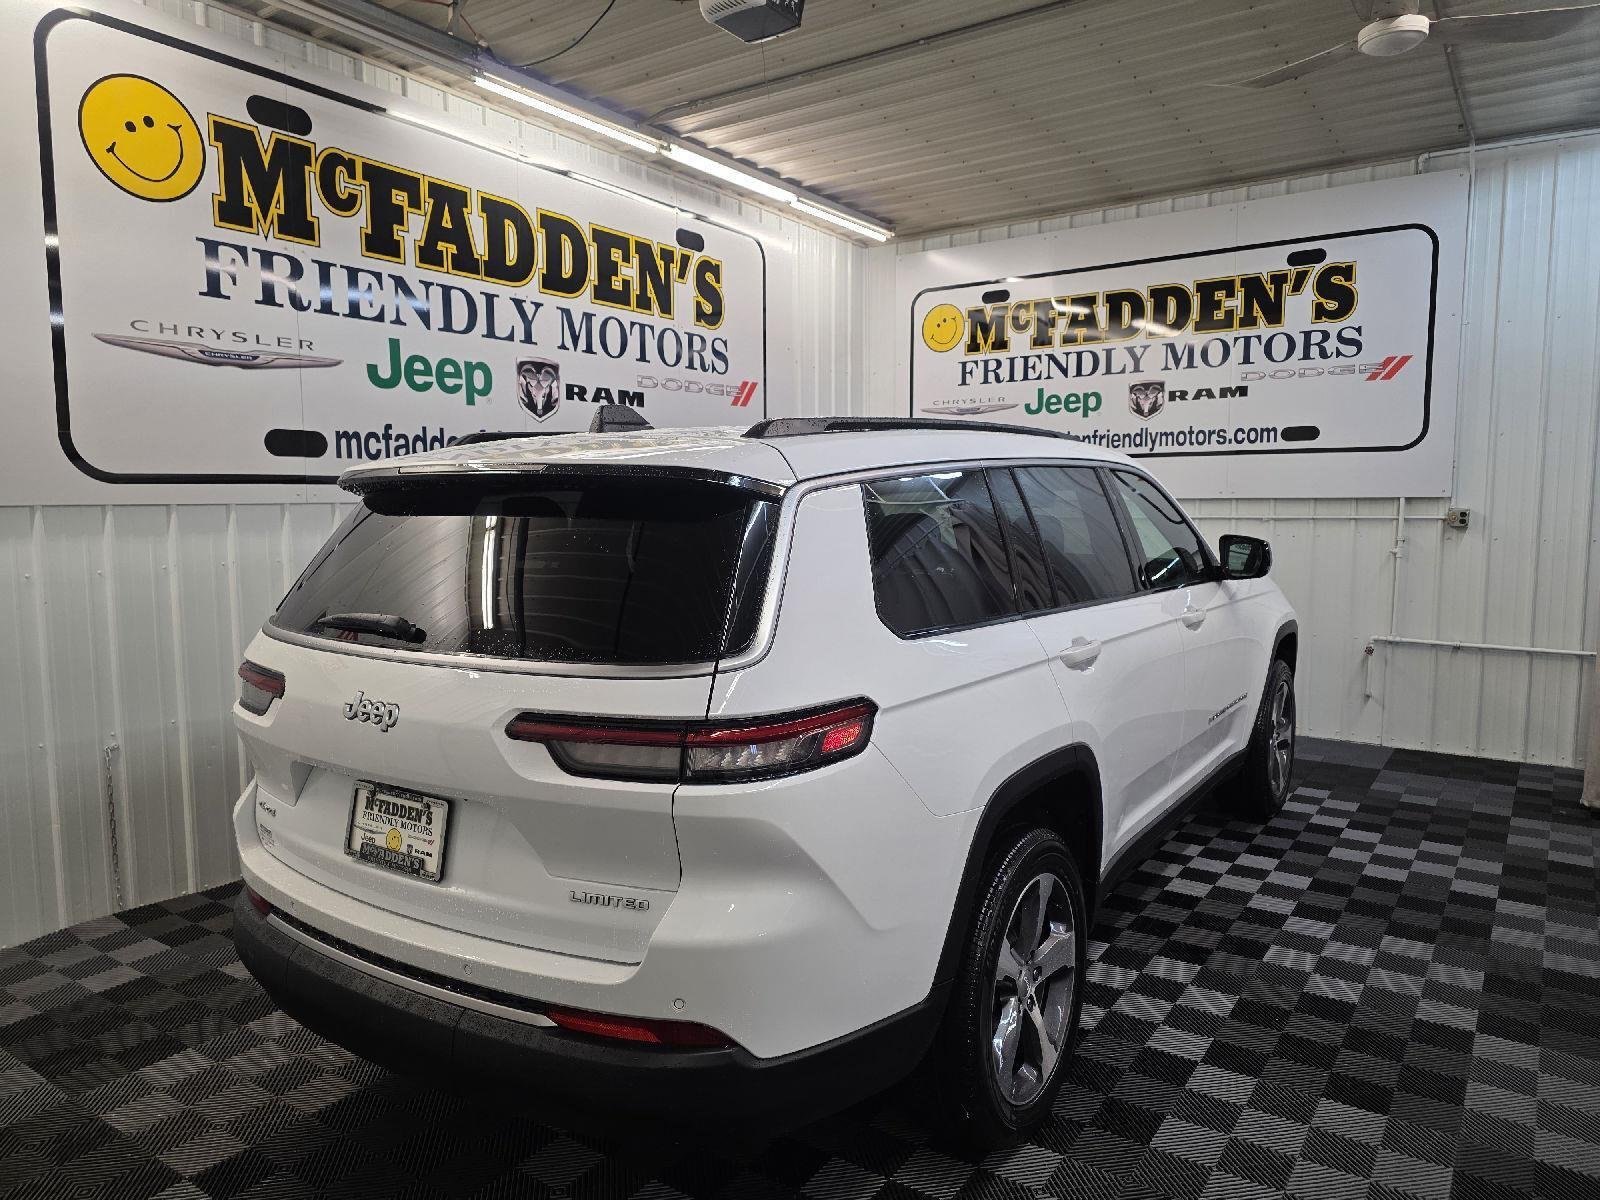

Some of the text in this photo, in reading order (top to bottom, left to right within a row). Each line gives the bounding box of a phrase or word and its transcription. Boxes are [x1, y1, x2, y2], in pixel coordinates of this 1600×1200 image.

[196, 236, 729, 375] FRIENDLY MOTORS
[130, 320, 314, 350] CHRYSLER
[957, 325, 1363, 386] FRIENDLY MOTORS
[366, 337, 493, 406] Jeep
[1241, 362, 1386, 382] DODGE
[565, 383, 645, 408] RAM
[637, 374, 742, 397] DODGE
[1168, 385, 1248, 402] RAM
[932, 396, 1006, 406] CHRYSLER
[1024, 387, 1102, 418] Jeep
[343, 691, 399, 732] Jeep
[362, 810, 400, 828] FRIENDLY
[400, 820, 433, 837] MOTORS
[360, 832, 376, 844] Jeep
[414, 848, 433, 858] RAM
[569, 890, 650, 911] LIMITED
